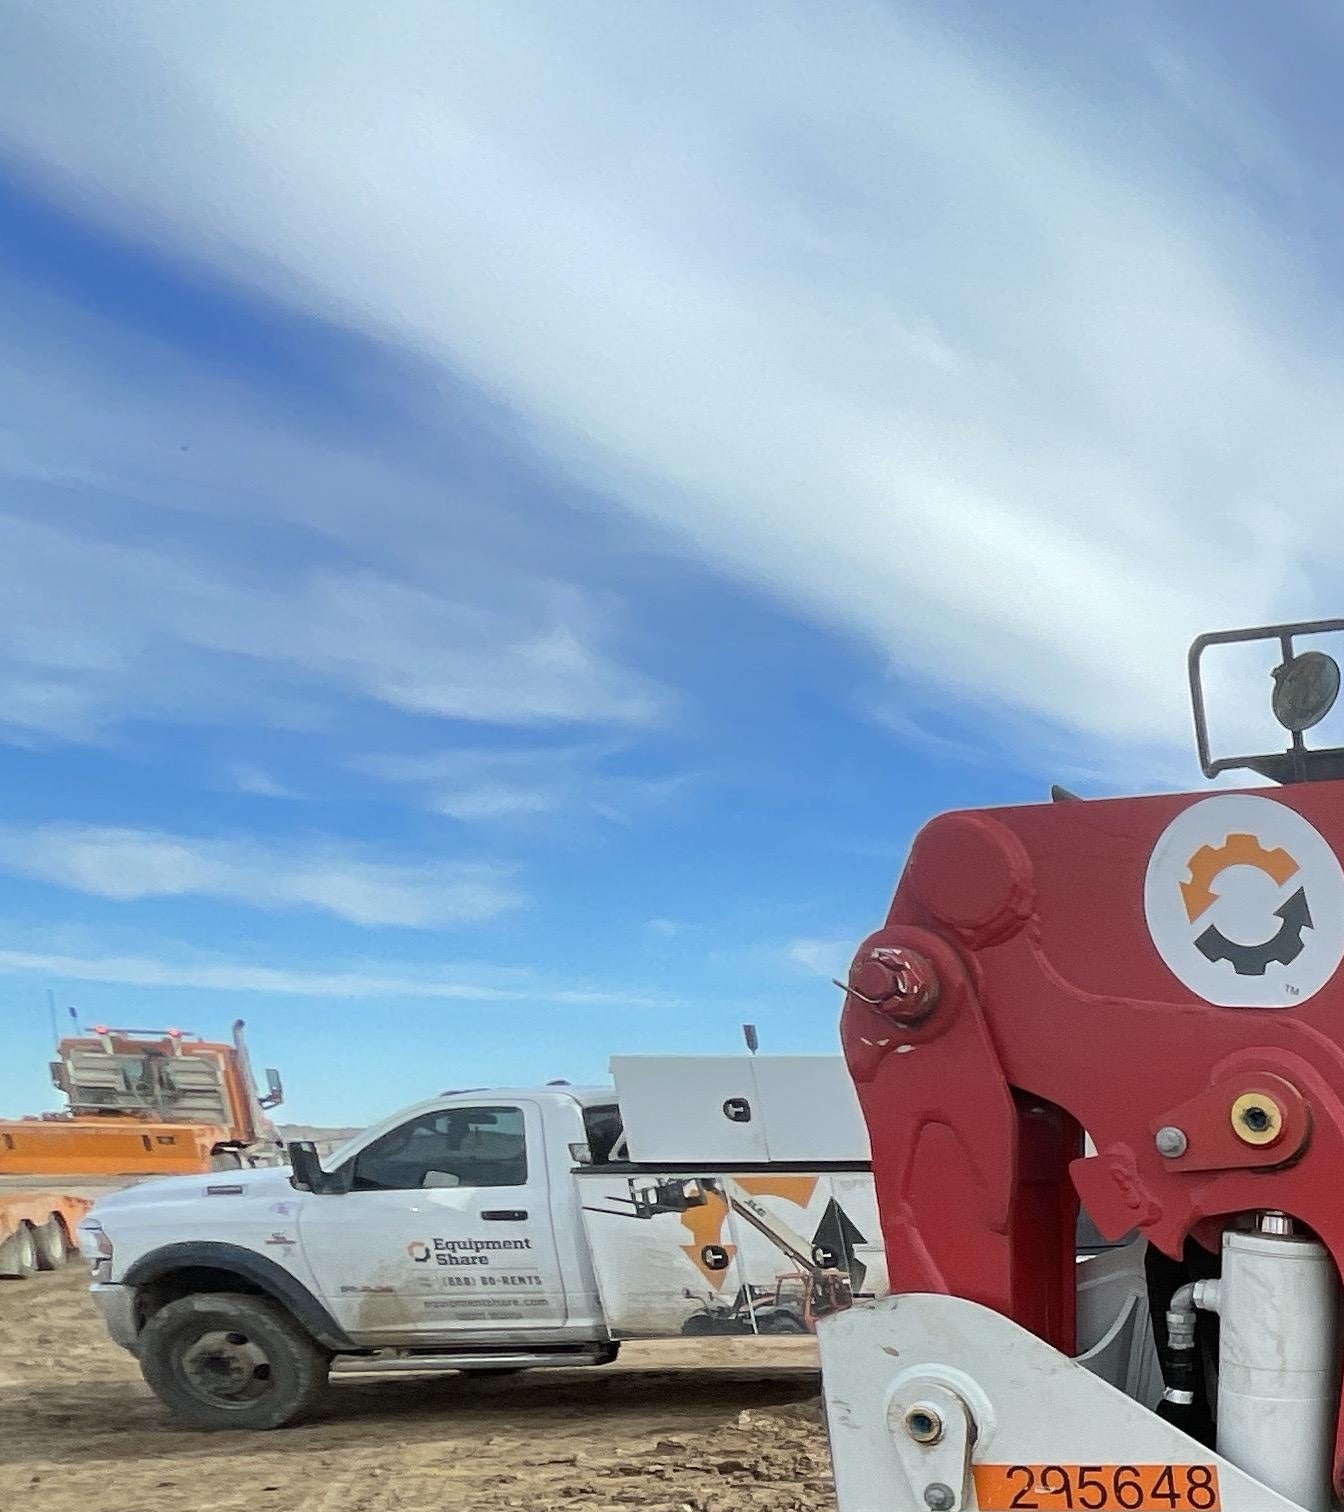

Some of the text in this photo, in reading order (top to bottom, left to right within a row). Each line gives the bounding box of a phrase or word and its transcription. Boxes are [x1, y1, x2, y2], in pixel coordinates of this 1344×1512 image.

[433, 1237, 532, 1254] Equipment
[436, 1253, 489, 1265] Share
[1005, 1464, 1218, 1511] 295648
